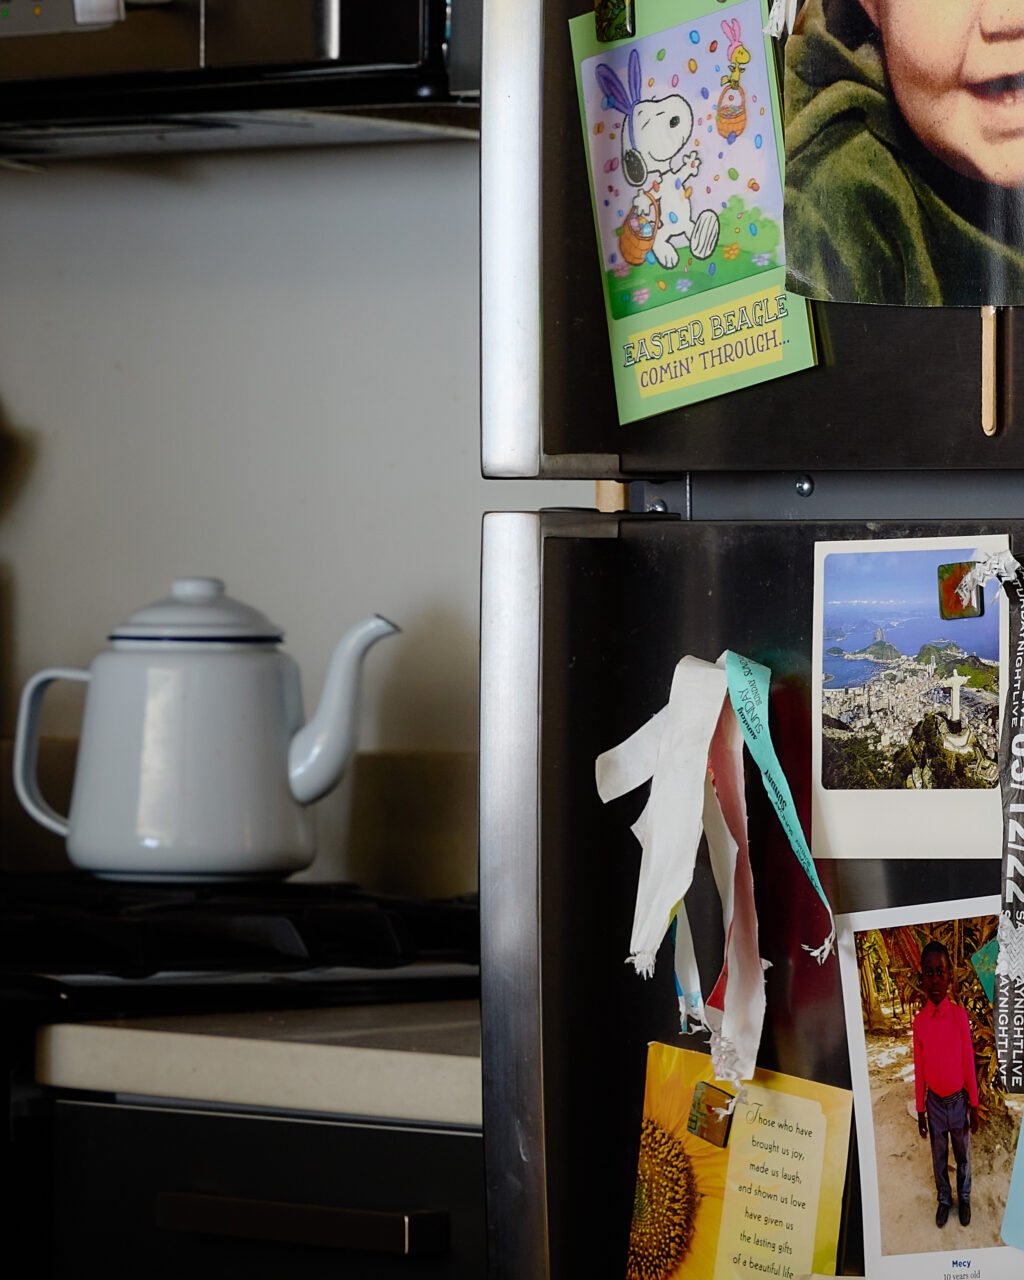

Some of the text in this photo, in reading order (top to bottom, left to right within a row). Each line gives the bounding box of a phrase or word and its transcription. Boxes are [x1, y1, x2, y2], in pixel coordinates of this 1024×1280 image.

[623, 293, 789, 368] EASTER BEAGLE
[698, 329, 790, 371] THROUGH...
[745, 1102, 813, 1138] Those who have
[751, 1137, 805, 1161] brought us joy,
[749, 1162, 802, 1185] made us laugh,
[738, 1183, 807, 1210] and shown us love
[744, 1207, 794, 1231] have given us
[739, 1231, 793, 1256] the lasting gifts
[732, 1254, 742, 1265] of
[749, 1257, 780, 1277] beautiful
[782, 1265, 794, 1280] life
[952, 1260, 972, 1268] Mecy
